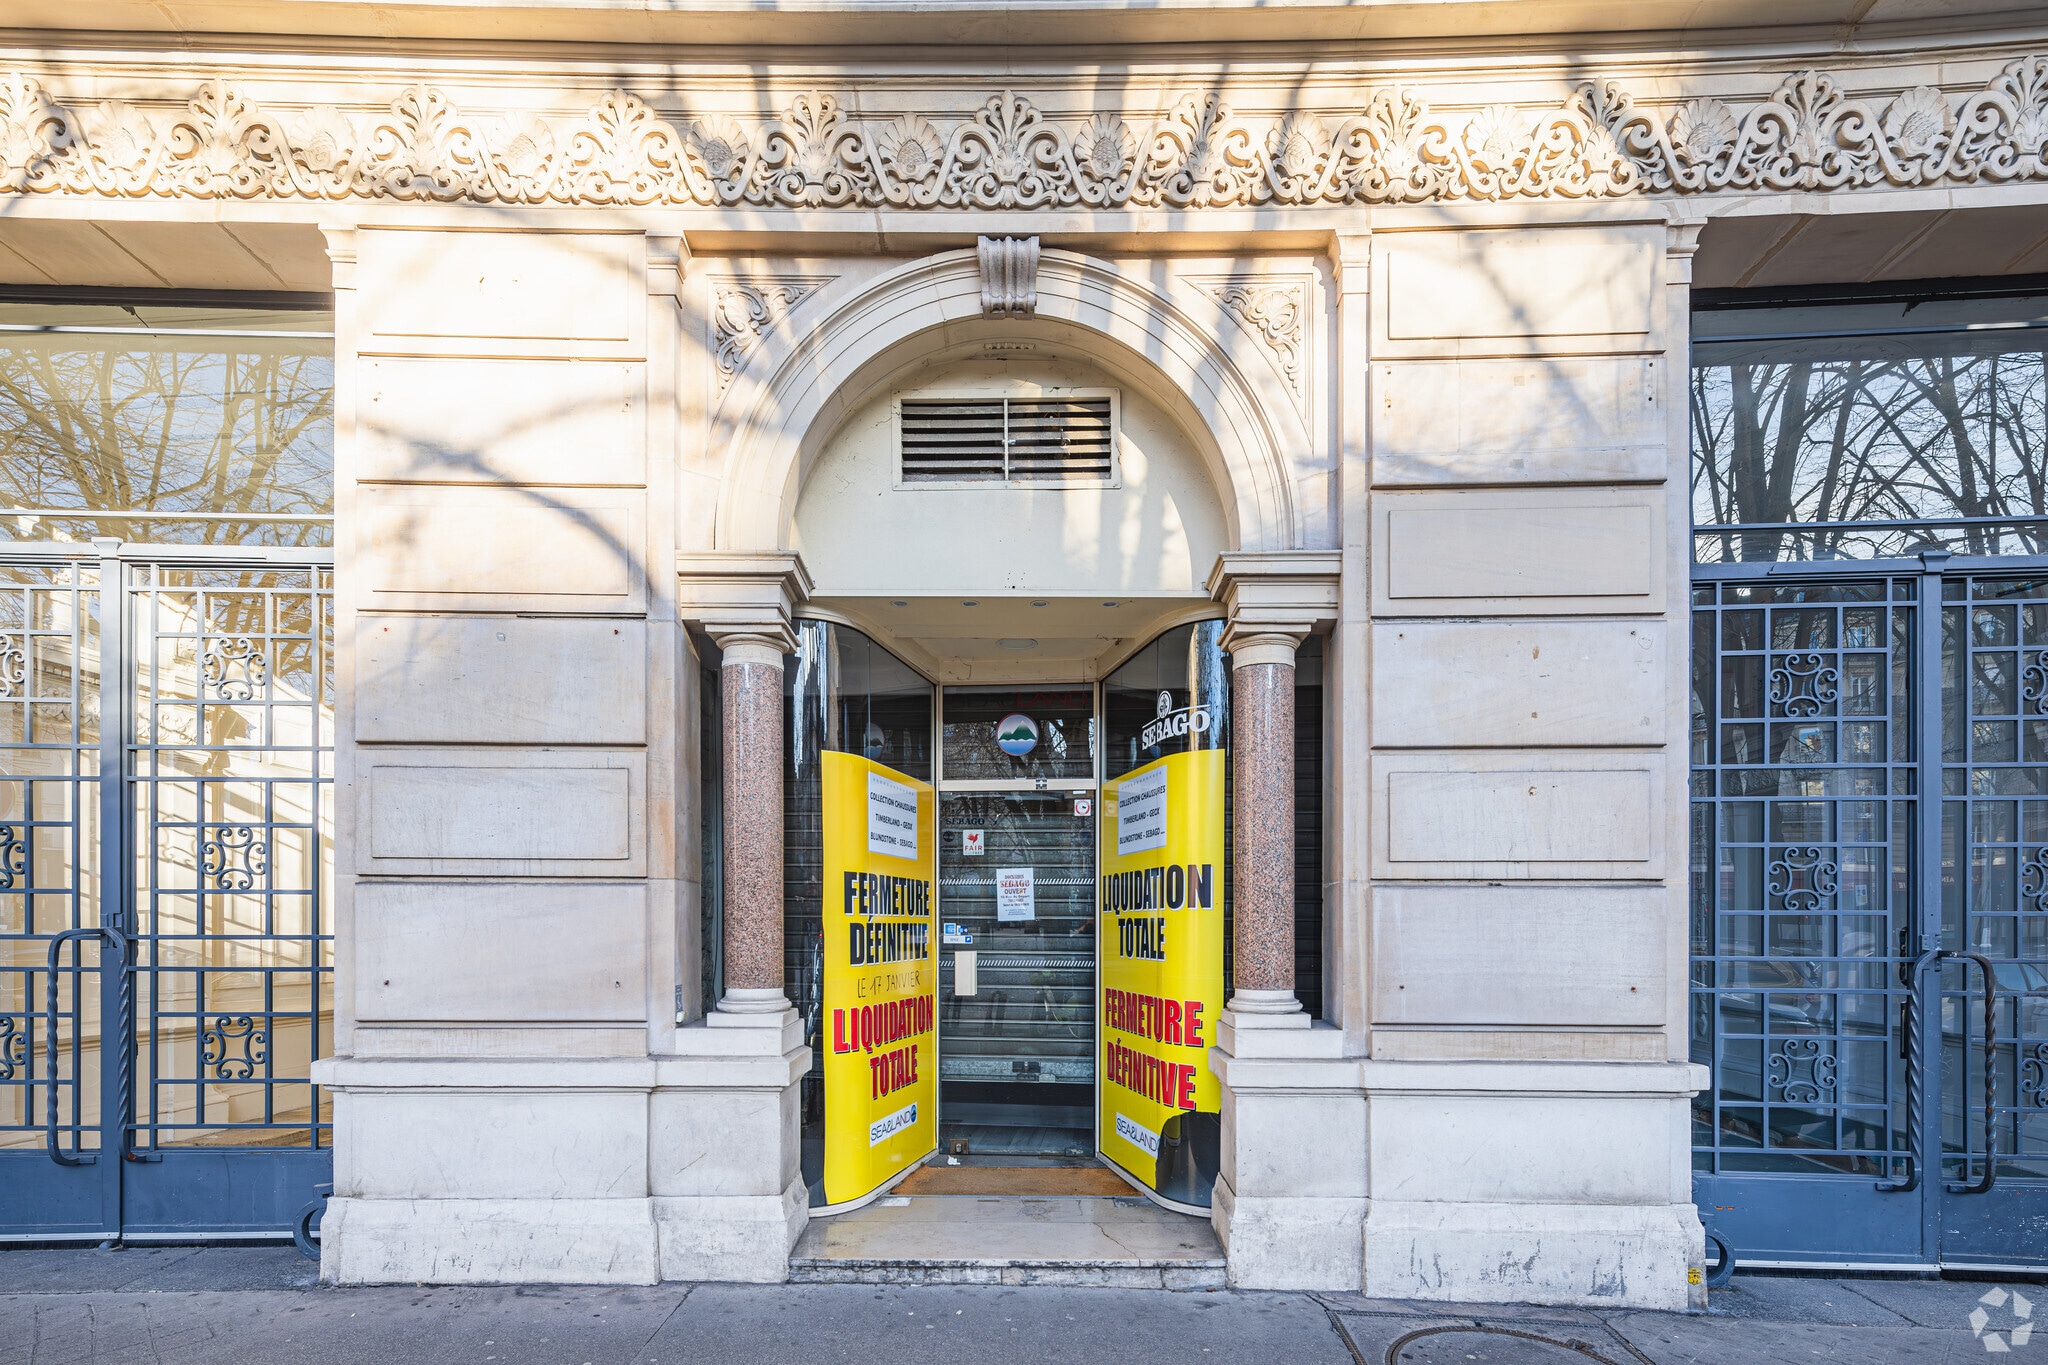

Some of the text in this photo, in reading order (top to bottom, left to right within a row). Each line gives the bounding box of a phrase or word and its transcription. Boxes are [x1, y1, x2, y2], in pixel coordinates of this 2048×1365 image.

[1142, 711, 1211, 750] SEBAGO
[870, 792, 916, 814] COLLECTION CHAUSSURES
[1119, 785, 1166, 808] COLLECTION CHAUSSURES
[875, 813, 900, 826] TIMBERLAND
[903, 821, 912, 830] GEOX
[1123, 812, 1146, 824] TIMBERLAND
[1149, 807, 1160, 818] GEOX
[1145, 827, 1160, 838] SEBAGO
[870, 831, 896, 844] BLUNDSTONE
[899, 838, 912, 848] SEBAGO
[843, 871, 930, 917] FERMETURE
[1102, 864, 1214, 917] LIQUIDATION
[849, 915, 929, 967] DÉFINITIVE
[1118, 917, 1166, 962] TOTALE
[857, 970, 920, 998] LE 17 JANVIER
[833, 994, 934, 1055] LIQUIDATION
[1105, 988, 1204, 1048] FERMETURE
[870, 1044, 918, 1101] TOTALE
[1107, 1037, 1197, 1111] DÉFINITIVE
[870, 1114, 912, 1142] SEA&LAND
[1116, 1117, 1157, 1152] SEA&LAND
